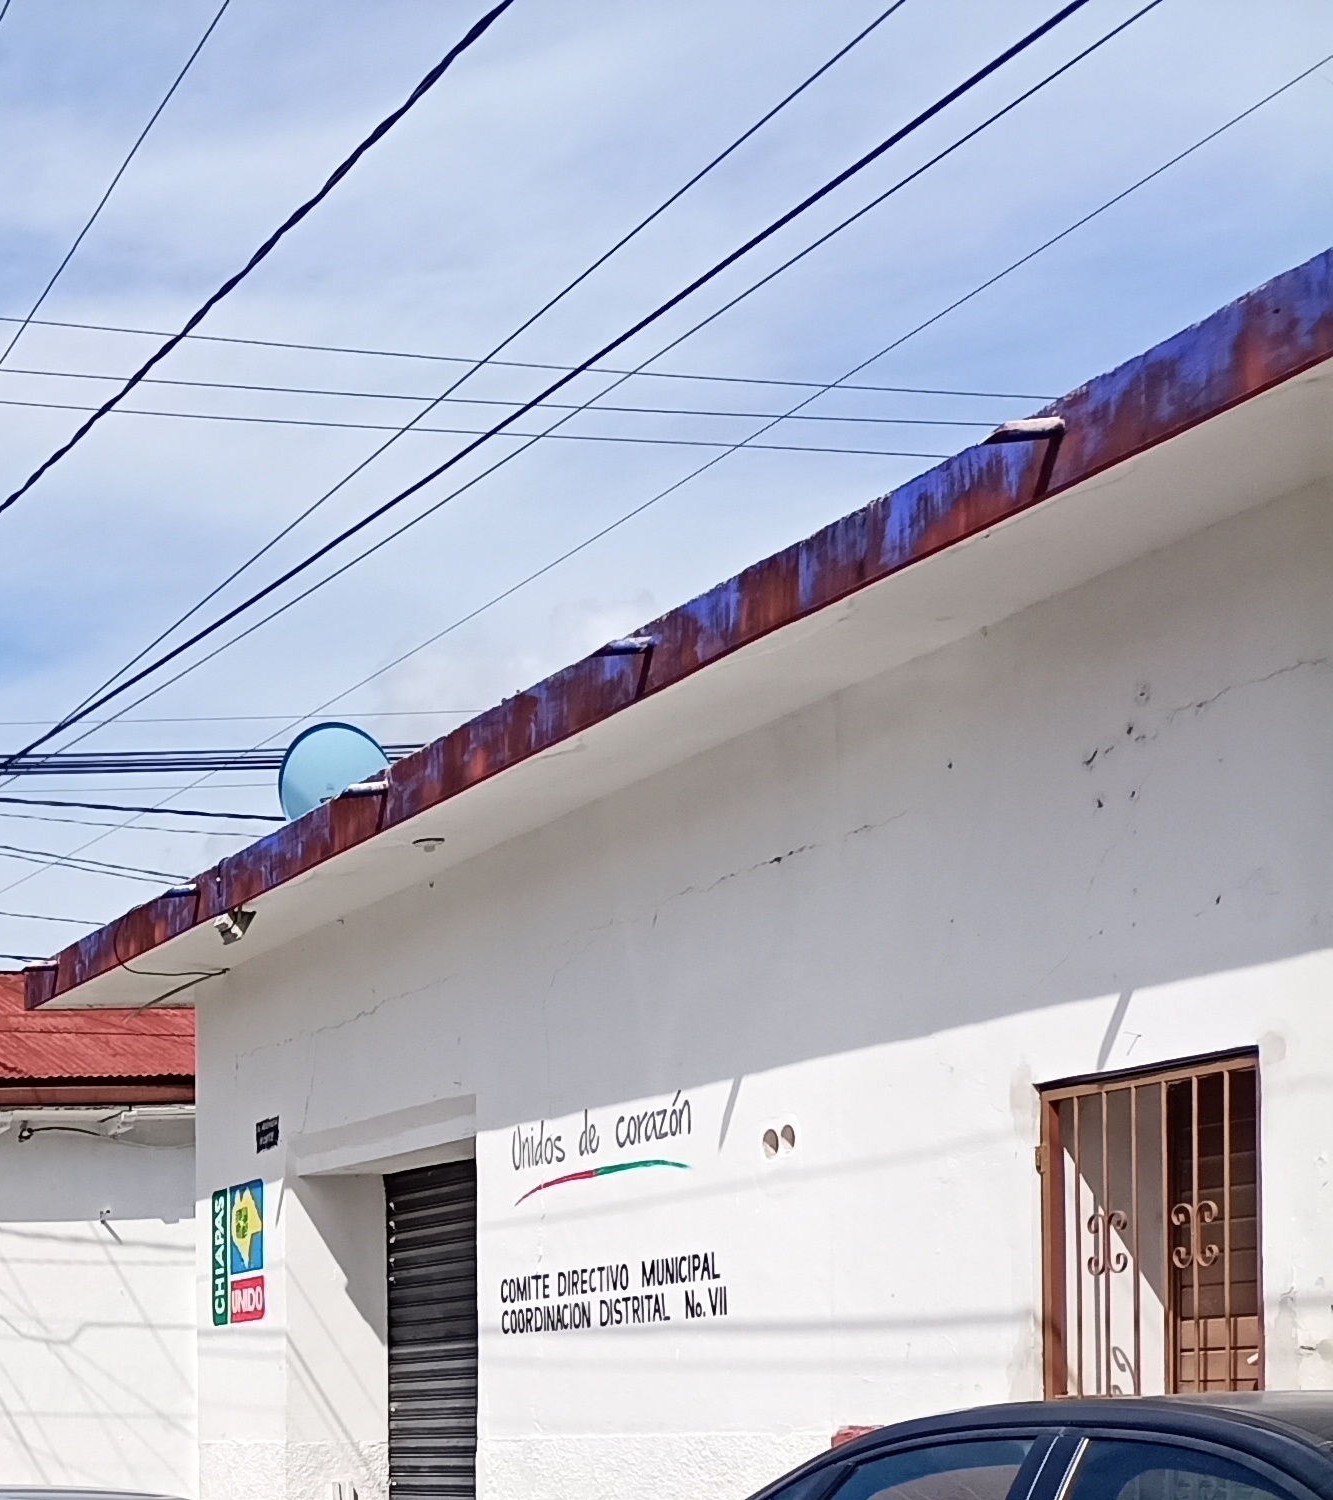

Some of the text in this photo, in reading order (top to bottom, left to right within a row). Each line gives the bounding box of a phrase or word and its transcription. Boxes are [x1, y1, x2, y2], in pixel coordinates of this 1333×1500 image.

[512, 1089, 691, 1170] Unidos de corazón
[214, 1195, 226, 1315] CHIAPAS
[500, 1251, 721, 1304] COMITE DIRECTIVO MUNICIPAL
[231, 1285, 263, 1314] UNIDO
[501, 1286, 728, 1334] COORDINACION DISTRITAL No. VII
